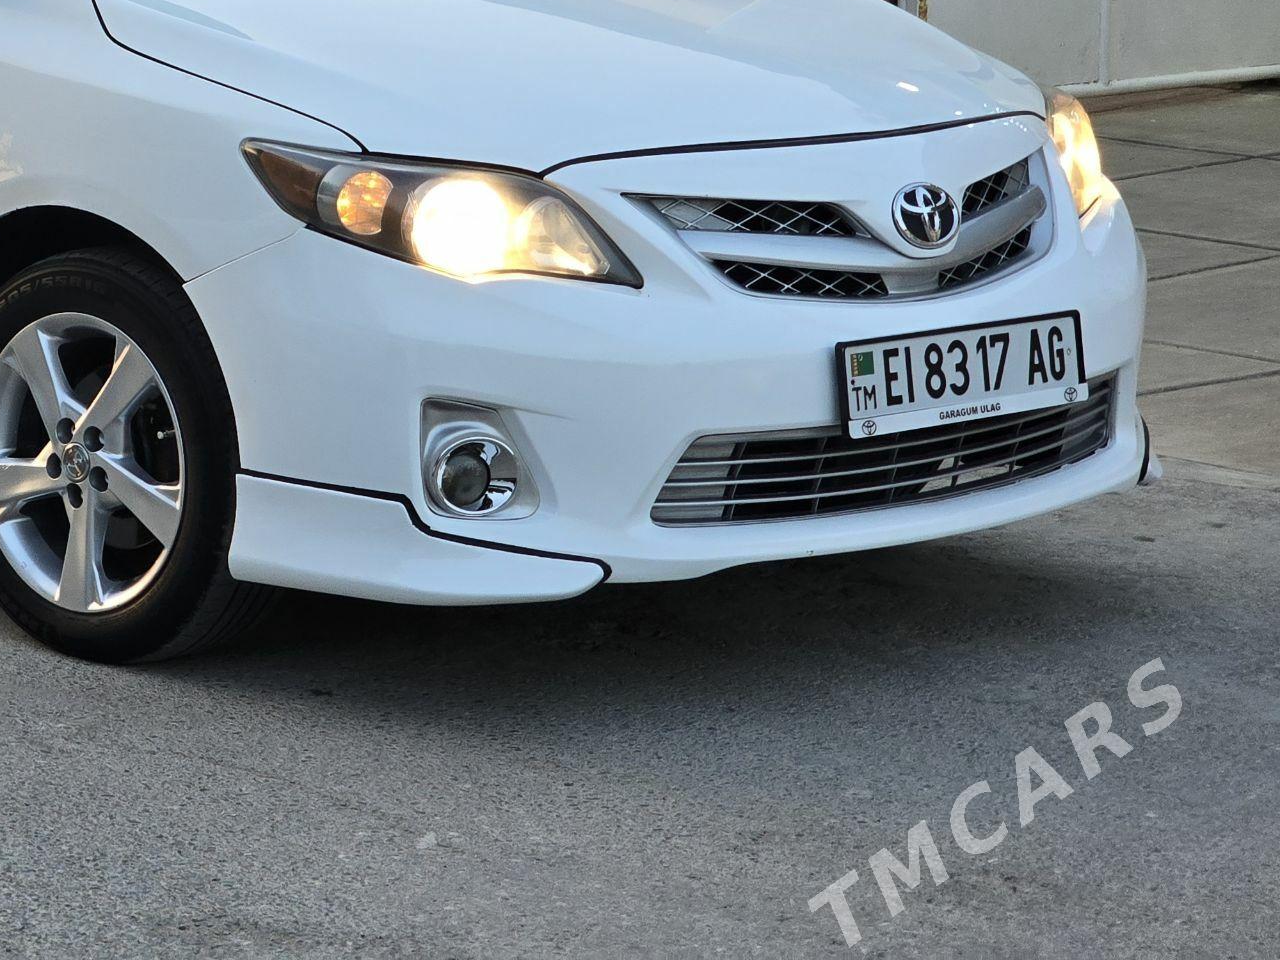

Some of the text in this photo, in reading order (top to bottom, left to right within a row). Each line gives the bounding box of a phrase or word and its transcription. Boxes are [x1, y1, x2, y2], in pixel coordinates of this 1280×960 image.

[924, 332, 1010, 399] 8317
[1028, 326, 1066, 386] AG
[851, 385, 877, 412] TM
[939, 403, 1001, 420] GARAGUM ULAG
